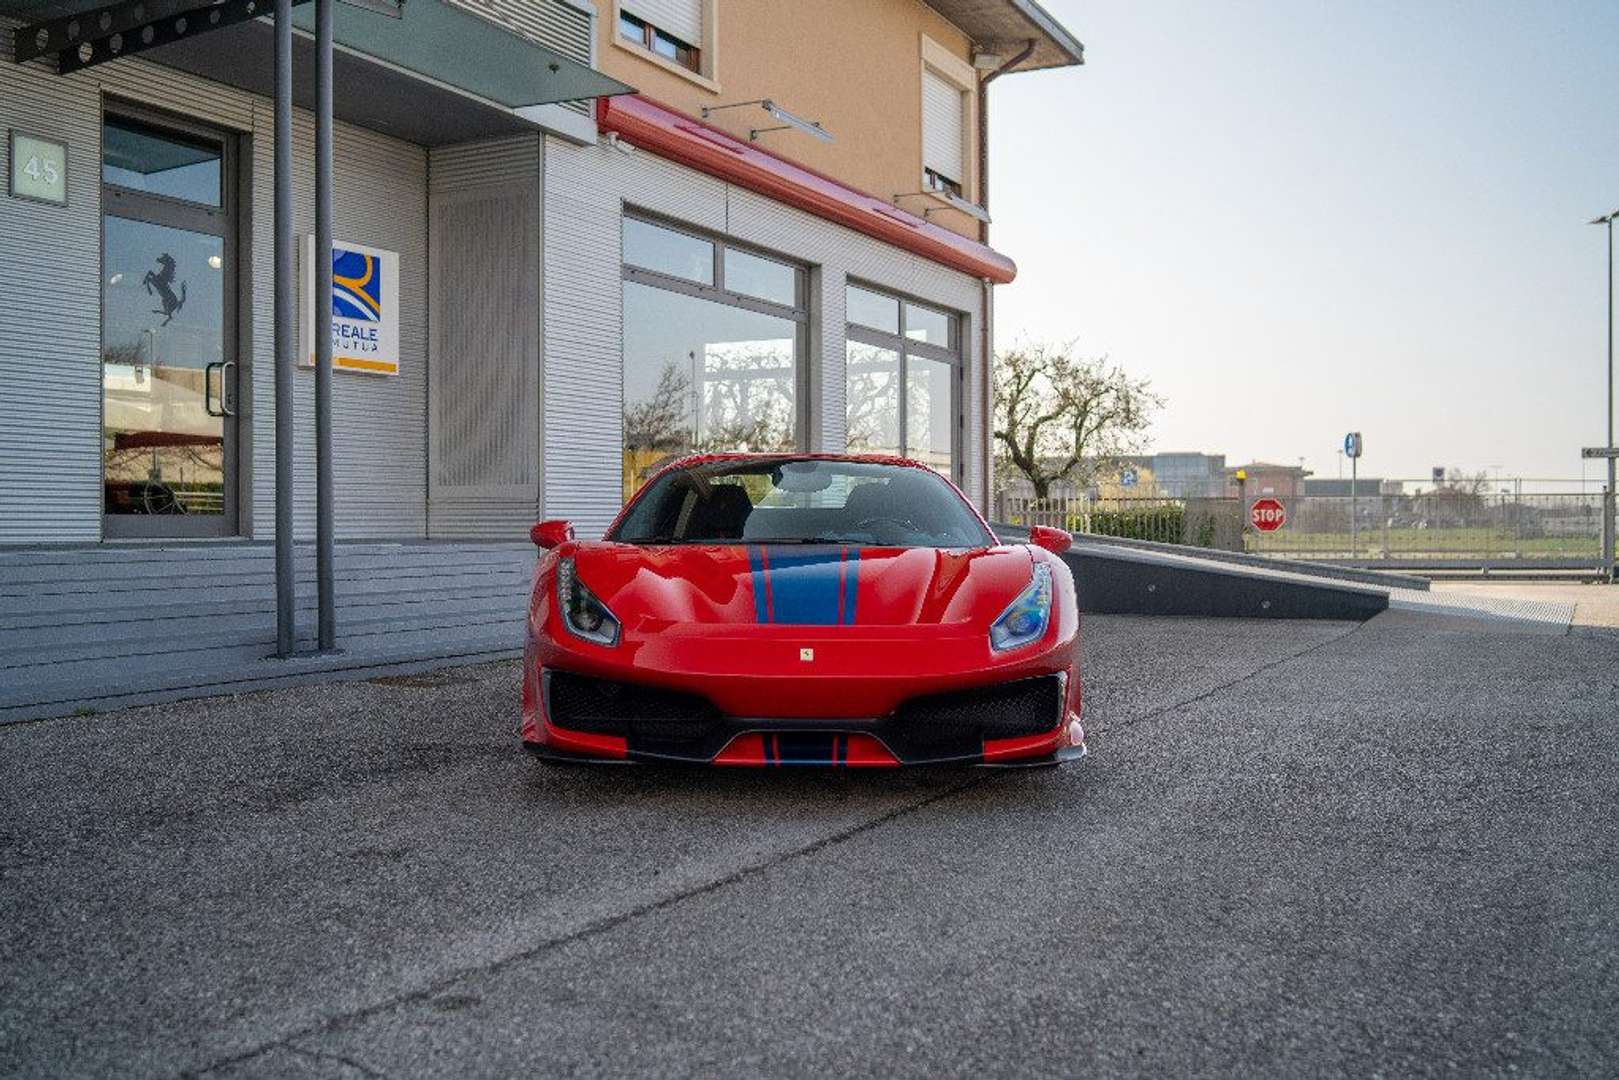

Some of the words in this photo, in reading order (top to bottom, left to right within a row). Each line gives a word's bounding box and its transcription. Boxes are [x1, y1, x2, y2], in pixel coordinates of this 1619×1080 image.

[23, 156, 58, 184] 45
[331, 322, 378, 342] REALE
[1252, 509, 1283, 522] STOP
